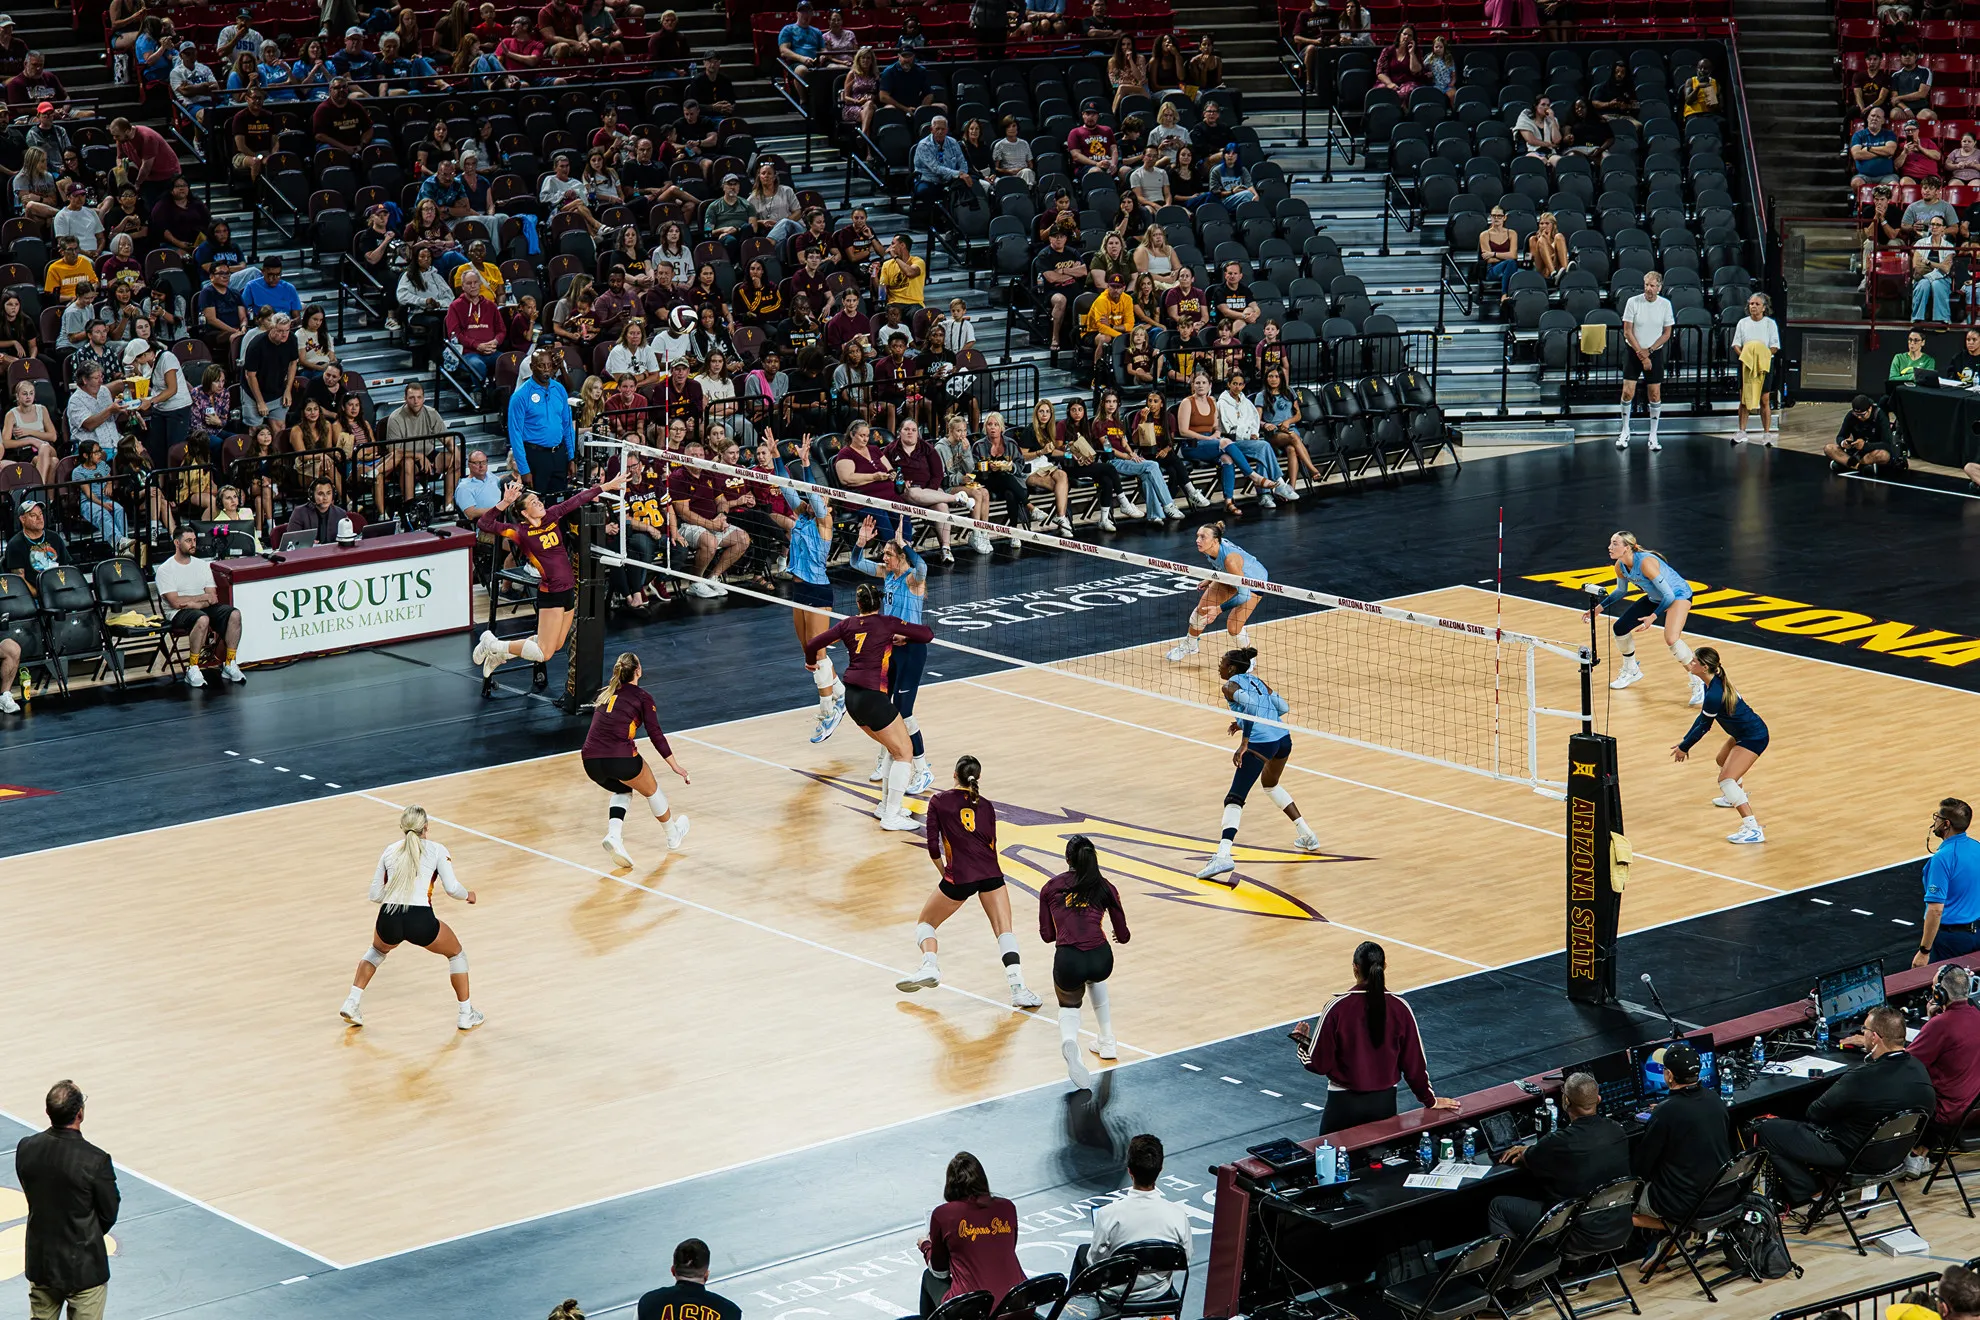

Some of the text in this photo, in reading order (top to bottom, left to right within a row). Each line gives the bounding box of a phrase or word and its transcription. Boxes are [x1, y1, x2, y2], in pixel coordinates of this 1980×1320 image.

[236, 40, 255, 51] USD
[681, 456, 694, 465] STATE
[735, 468, 769, 481] ARIZONA STATE
[811, 485, 847, 499] ARIZONA STATE
[631, 499, 664, 527] 26
[891, 503, 928, 517] ARIZONA STATE
[973, 520, 1012, 534] ARIZONA STATE
[539, 531, 560, 550] 20
[1059, 539, 1099, 554] ARIZONA STATE
[1148, 558, 1190, 573] ARIZONA STATE
[1241, 577, 1284, 593] ARIZONA STATE
[272, 568, 432, 622] SPROUTS
[922, 590, 1059, 616] MARKET
[937, 576, 1203, 631] PROUTS
[1338, 598, 1382, 615] ARIZONA STATE
[280, 604, 425, 640] FARMERS MARKET
[1438, 618, 1486, 636] ARIZONA STATE
[854, 632, 868, 653] 7
[1250, 680, 1262, 696] 1
[606, 694, 618, 713] 1
[960, 807, 975, 832] 8
[1571, 796, 1596, 980] ARIZONA STATE
[958, 1216, 1012, 1241] Arizona State
[750, 1247, 921, 1308] ARKET
